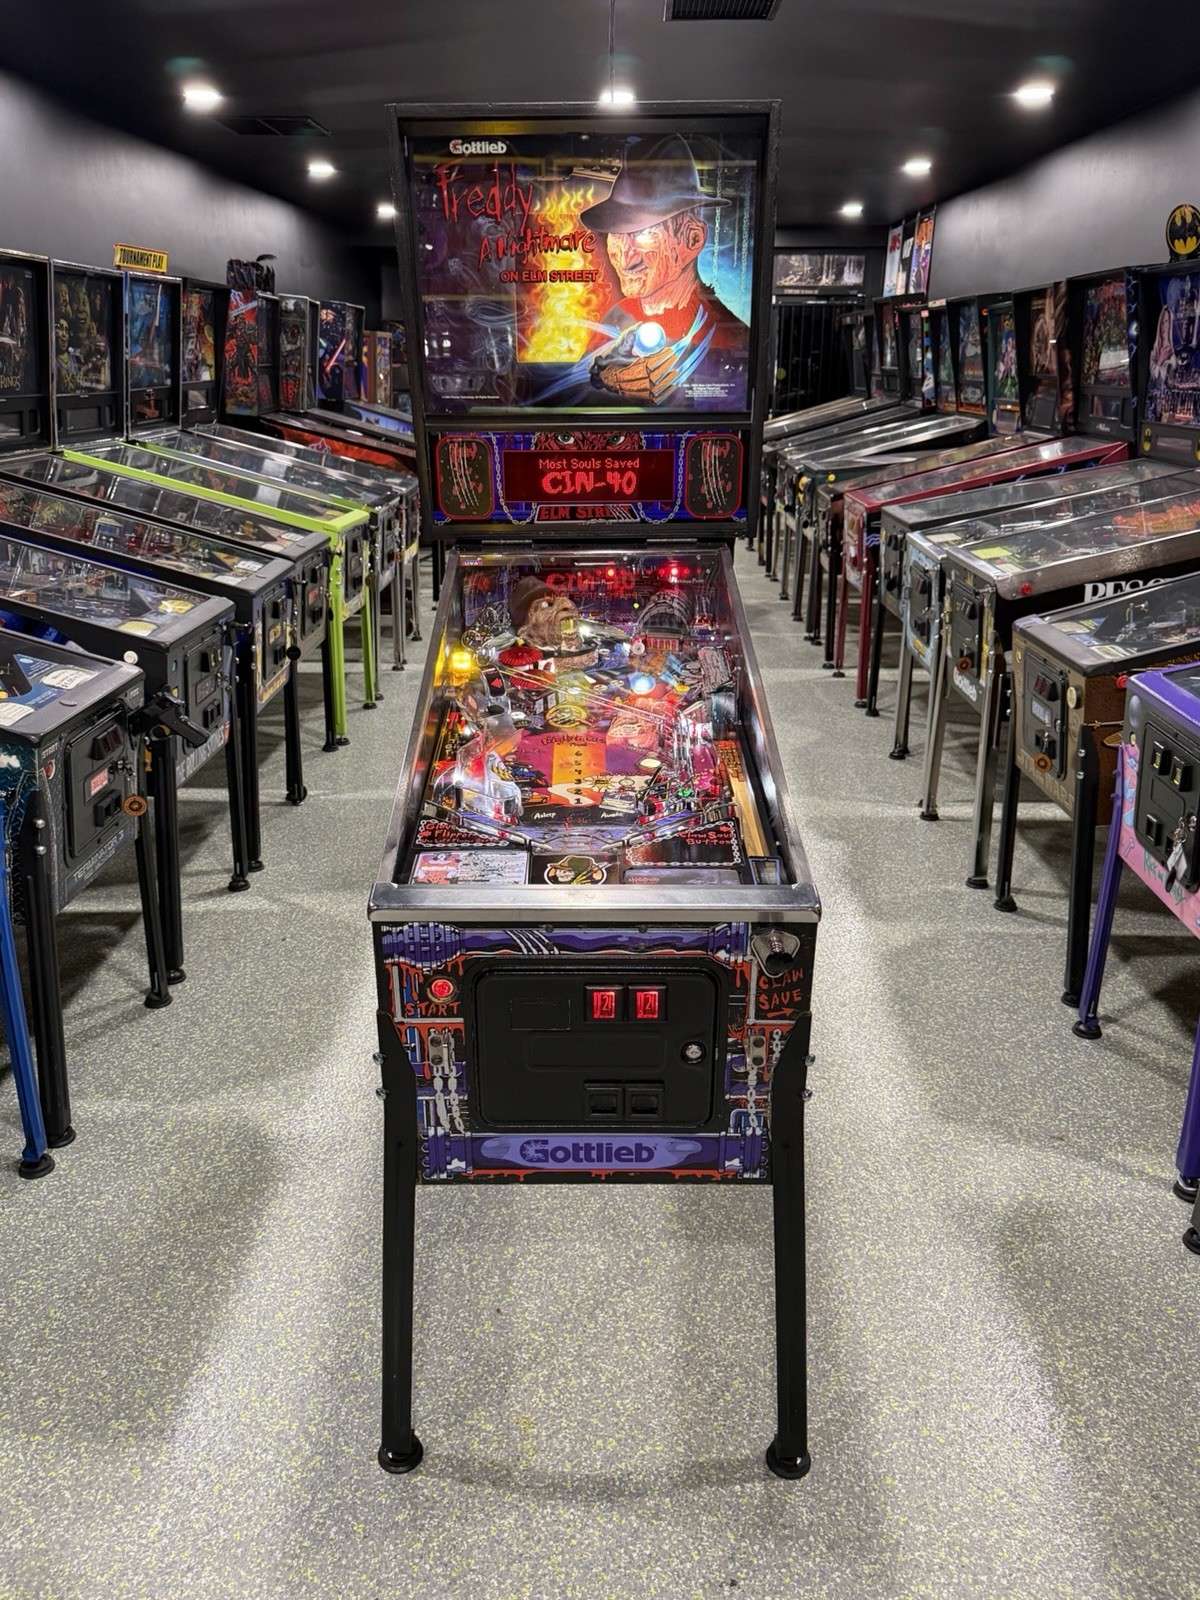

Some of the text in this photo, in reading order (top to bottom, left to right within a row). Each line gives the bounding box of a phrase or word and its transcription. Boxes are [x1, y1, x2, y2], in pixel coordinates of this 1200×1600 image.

[450, 139, 507, 155] Gottlieb
[433, 157, 533, 237] Freddy
[479, 226, 597, 268] A Nightmare
[119, 247, 165, 270] TOURNAMENT PLAY
[501, 270, 600, 282] ON ELM STREET
[539, 458, 639, 469] Most Souls Saved
[541, 471, 637, 495] CIN-40
[539, 506, 571, 520] ELM
[600, 811, 624, 819] Awake
[435, 830, 474, 838] Flipper
[73, 836, 117, 881] TERMINATOR
[119, 829, 124, 841] 3
[759, 968, 804, 990] CLAW
[406, 1001, 460, 1017] START
[759, 988, 802, 1010] SAVE
[519, 1139, 655, 1164] Gottlieb
